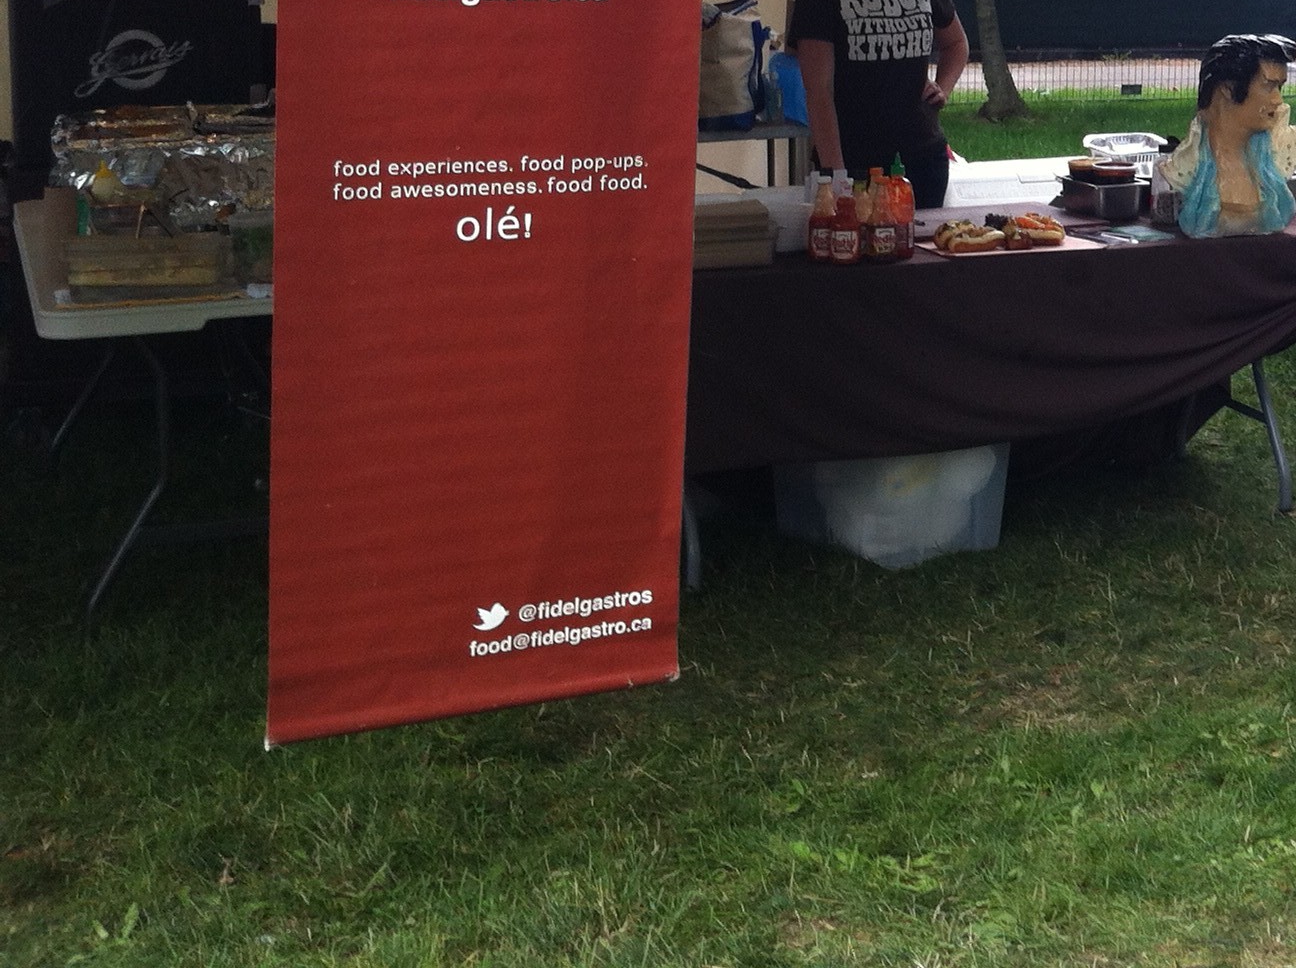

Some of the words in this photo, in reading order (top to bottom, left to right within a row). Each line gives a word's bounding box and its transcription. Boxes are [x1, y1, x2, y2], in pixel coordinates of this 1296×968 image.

[845, 14, 928, 34] WITHOUT
[333, 159, 380, 177] food
[387, 158, 513, 178] experiences.
[520, 155, 564, 172] food
[571, 154, 649, 173] pop-ups.
[332, 183, 382, 201] food
[390, 181, 543, 199] awesomeness.
[547, 176, 593, 194] food
[599, 173, 648, 191] food.
[456, 205, 532, 242] olé!
[518, 589, 653, 622] @fidelgastros
[469, 617, 652, 657] food@fidelgastro.ca
